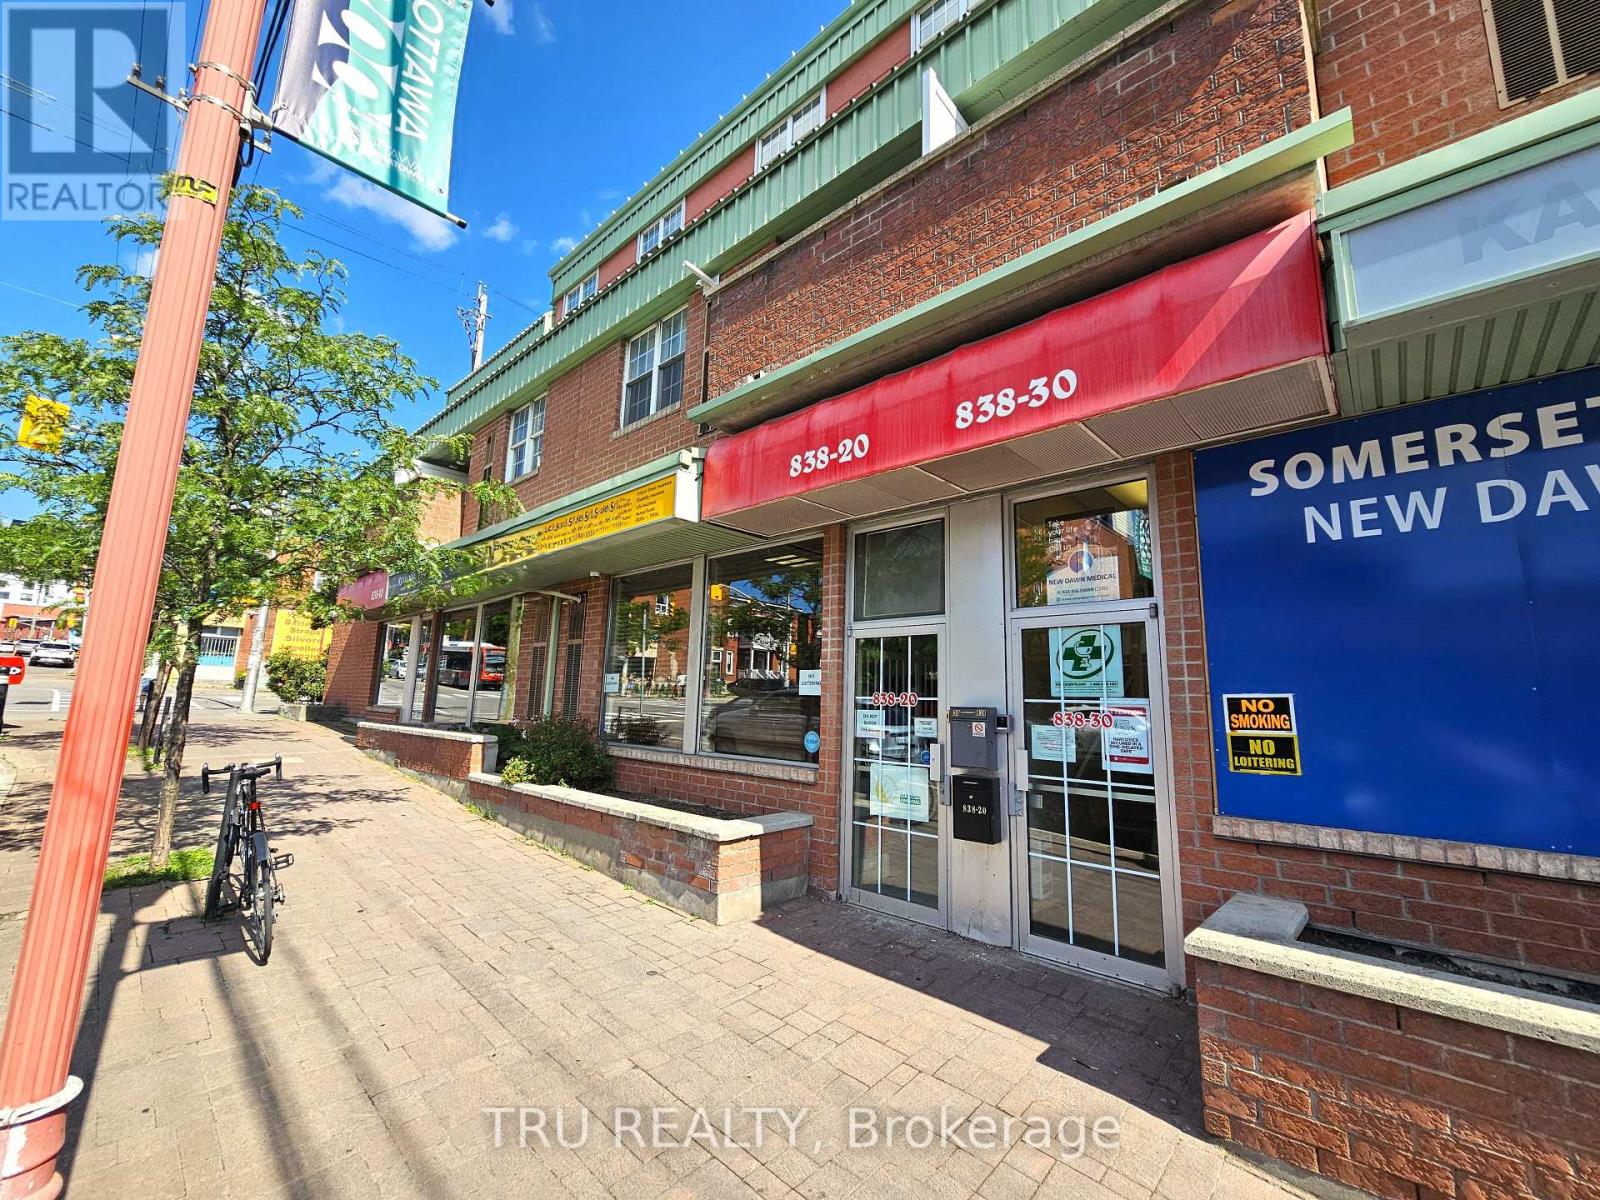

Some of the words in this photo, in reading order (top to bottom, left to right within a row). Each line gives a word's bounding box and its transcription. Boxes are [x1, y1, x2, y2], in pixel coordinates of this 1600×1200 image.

[394, 0, 445, 140] OTTAWA
[954, 368, 1078, 430] 838-30
[1248, 395, 1600, 497] SOMERSE
[789, 433, 870, 478] 838-20
[1303, 486, 1447, 544] NEW
[1048, 578, 1064, 586] NEW
[1064, 576, 1086, 585] DAWN
[1086, 573, 1117, 582] MEDICAL
[872, 692, 918, 707] 838-20
[1241, 699, 1275, 713] NO
[1053, 712, 1114, 729] 838-30
[1230, 713, 1291, 729] SMOKING
[1249, 739, 1276, 756] NO
[1234, 756, 1295, 769] LOITERING
[962, 804, 987, 815] 838-20
